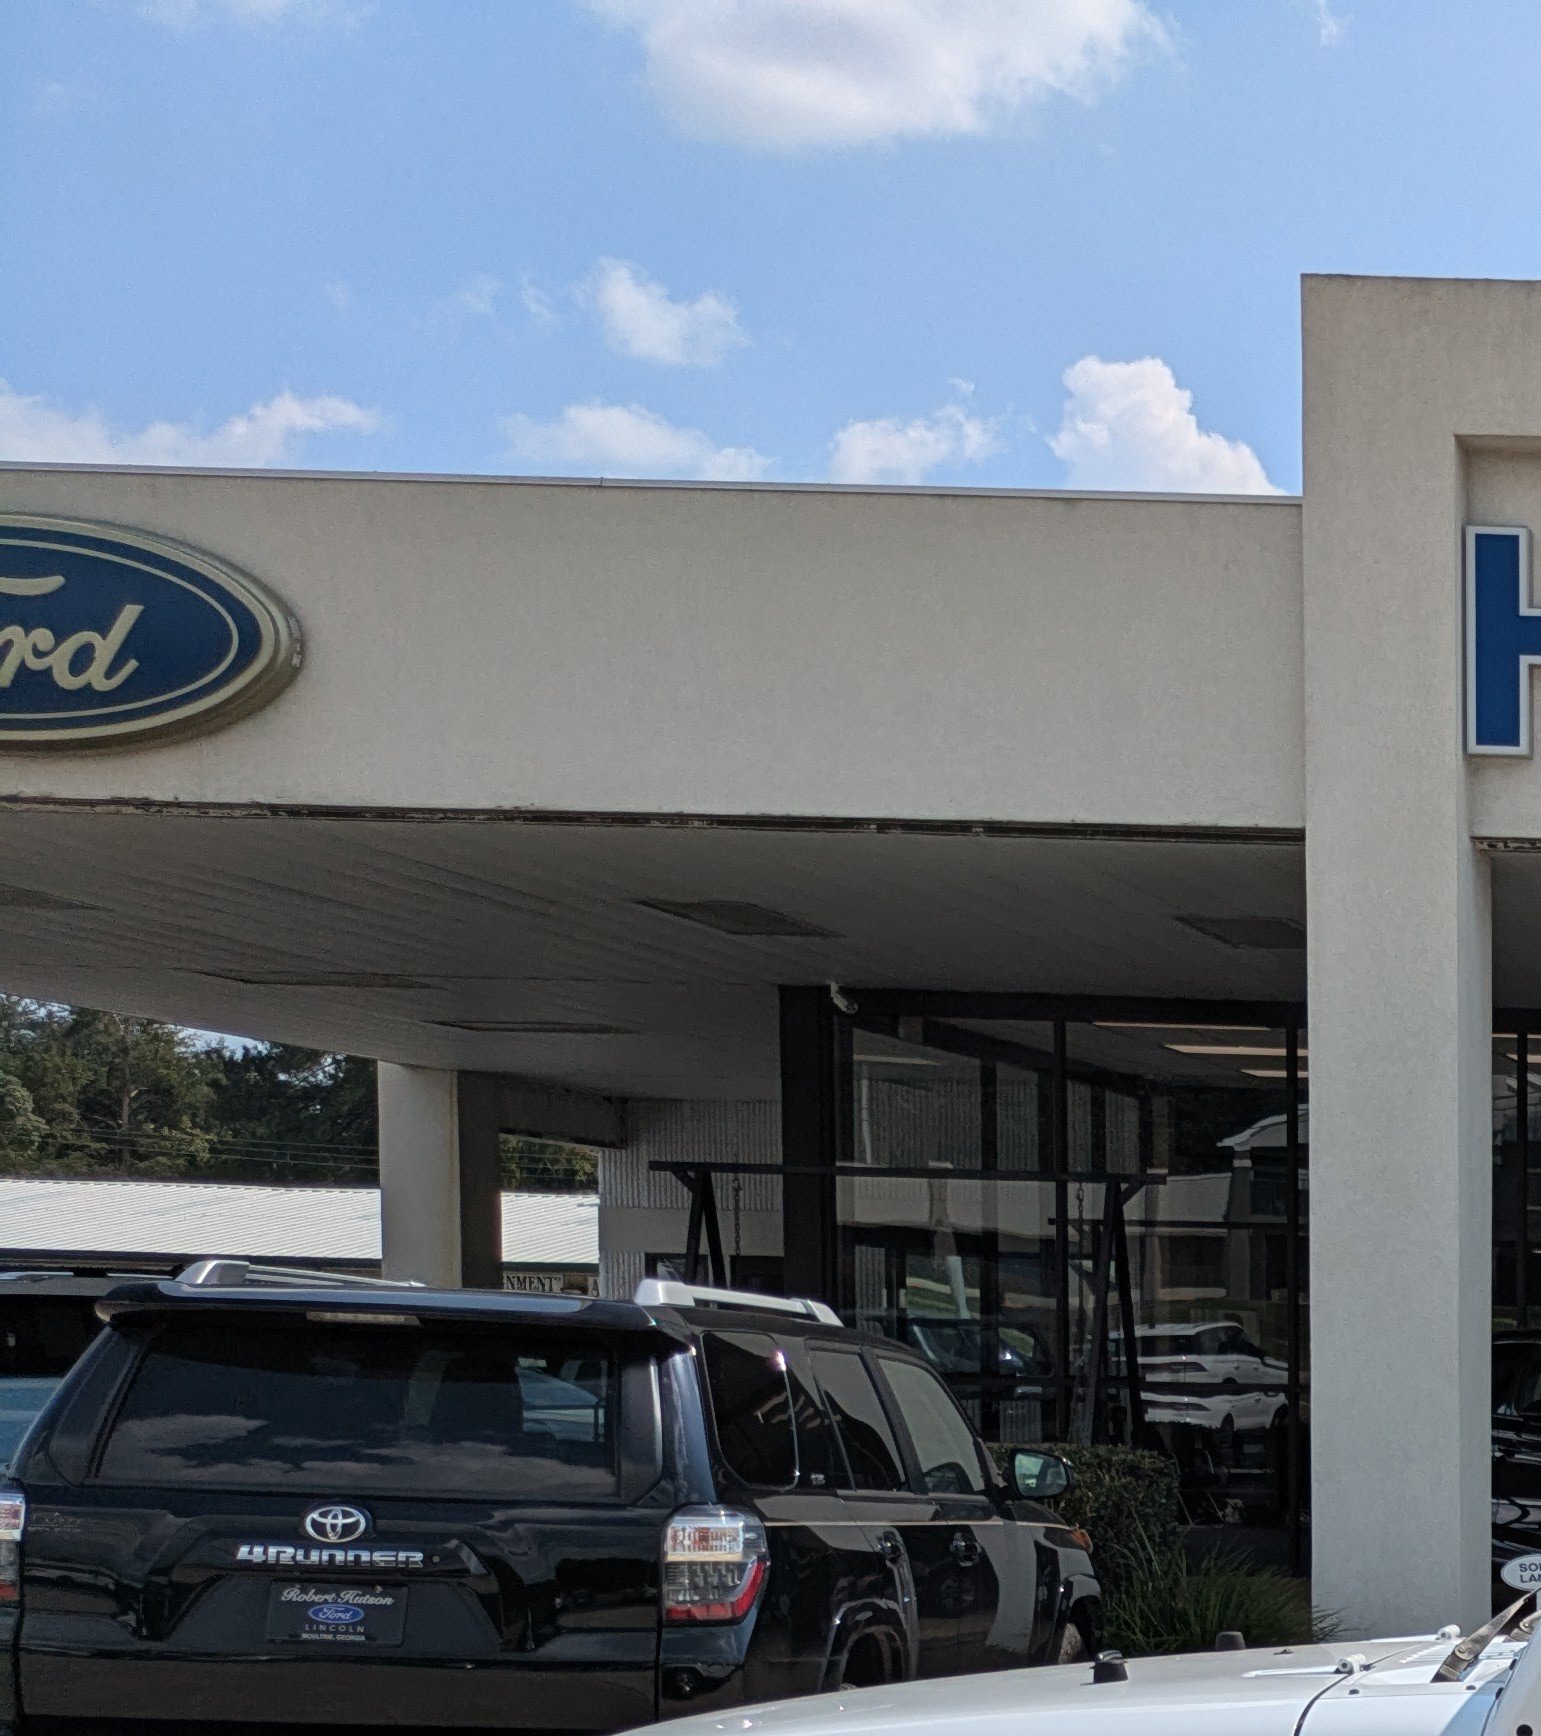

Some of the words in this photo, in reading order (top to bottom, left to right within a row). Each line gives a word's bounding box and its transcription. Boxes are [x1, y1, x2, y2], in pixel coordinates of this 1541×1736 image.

[0, 575, 145, 692] rd
[281, 1587, 337, 1603] Robert
[338, 1590, 395, 1606] Hutson
[318, 1607, 354, 1619] Ford
[305, 1623, 365, 1633] LINCOLN
